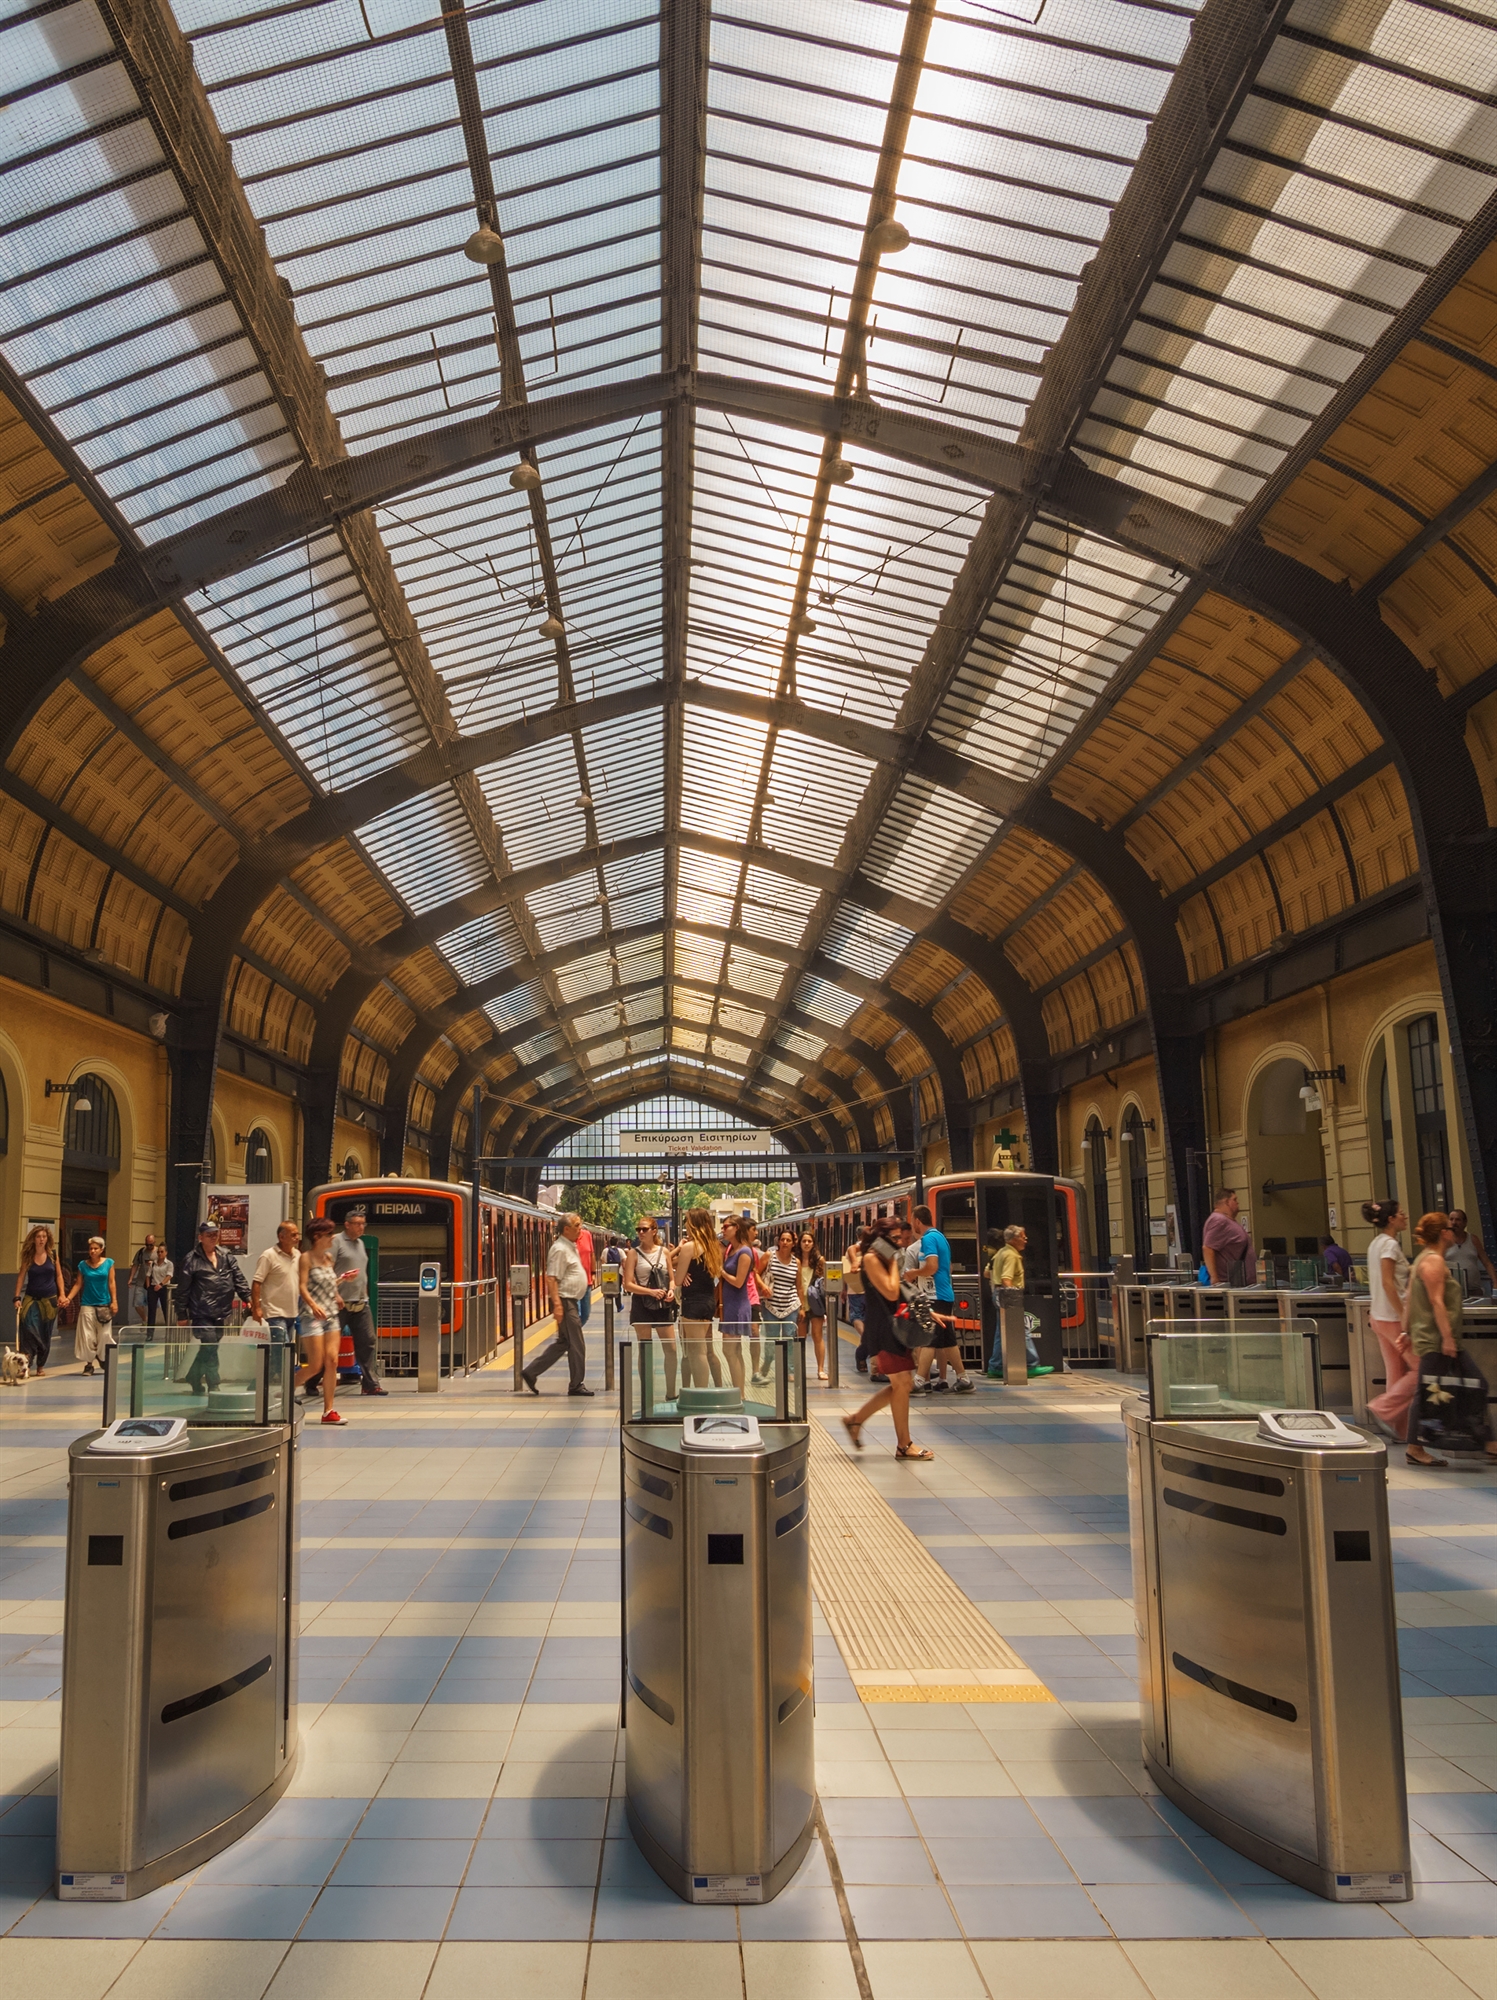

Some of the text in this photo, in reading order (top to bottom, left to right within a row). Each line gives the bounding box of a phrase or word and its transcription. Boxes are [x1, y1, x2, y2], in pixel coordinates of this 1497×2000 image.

[634, 1132, 757, 1143] Επικύρωση Εισιτηρίων
[376, 1203, 422, 1214] ΠΕΙΡΑΙΑ
